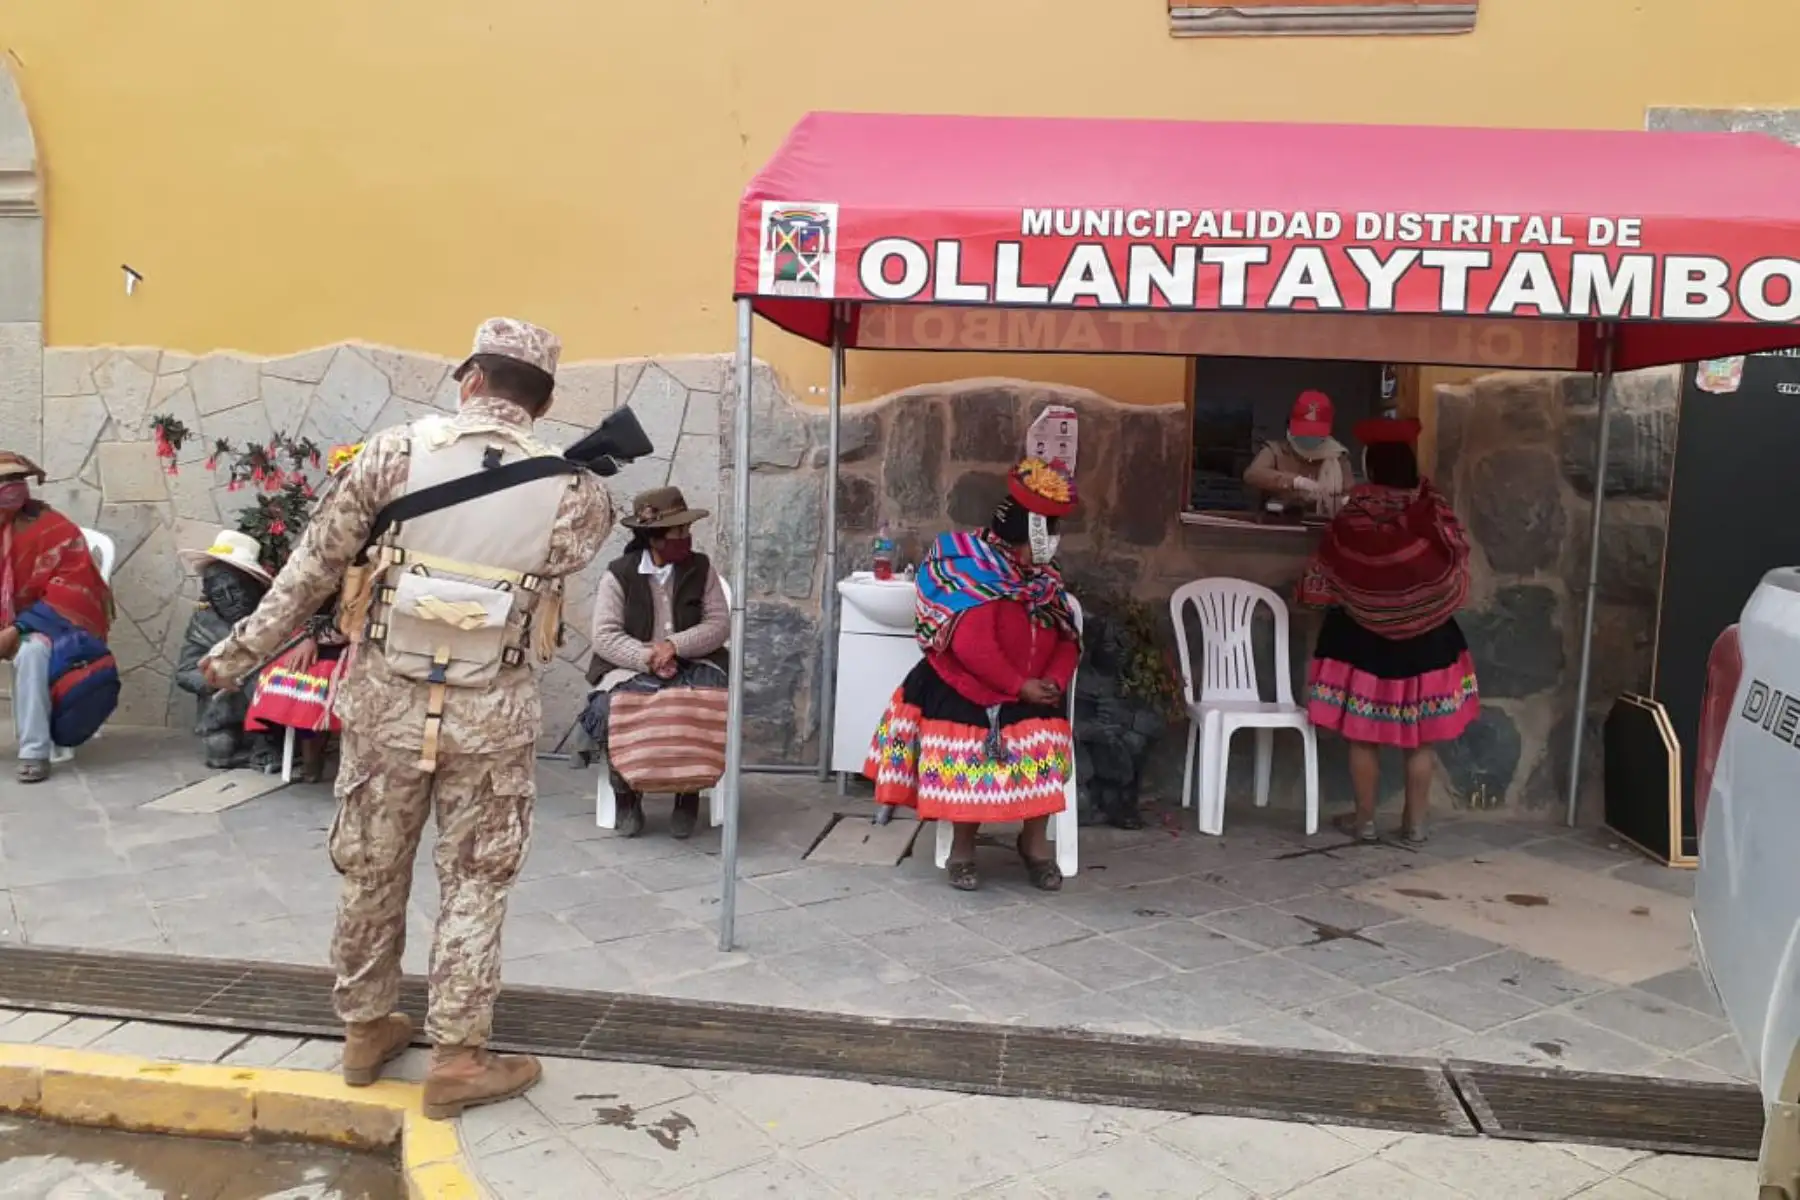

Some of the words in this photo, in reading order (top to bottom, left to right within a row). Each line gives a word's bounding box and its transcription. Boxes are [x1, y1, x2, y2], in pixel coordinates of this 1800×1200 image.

[1021, 207, 1341, 241] MUNICIPALIDAD
[1355, 211, 1574, 247] DISTRITAL
[1588, 216, 1642, 248] DE
[858, 236, 1800, 323] OLLANTAYTAMBO
[1742, 679, 1800, 750] DIE
